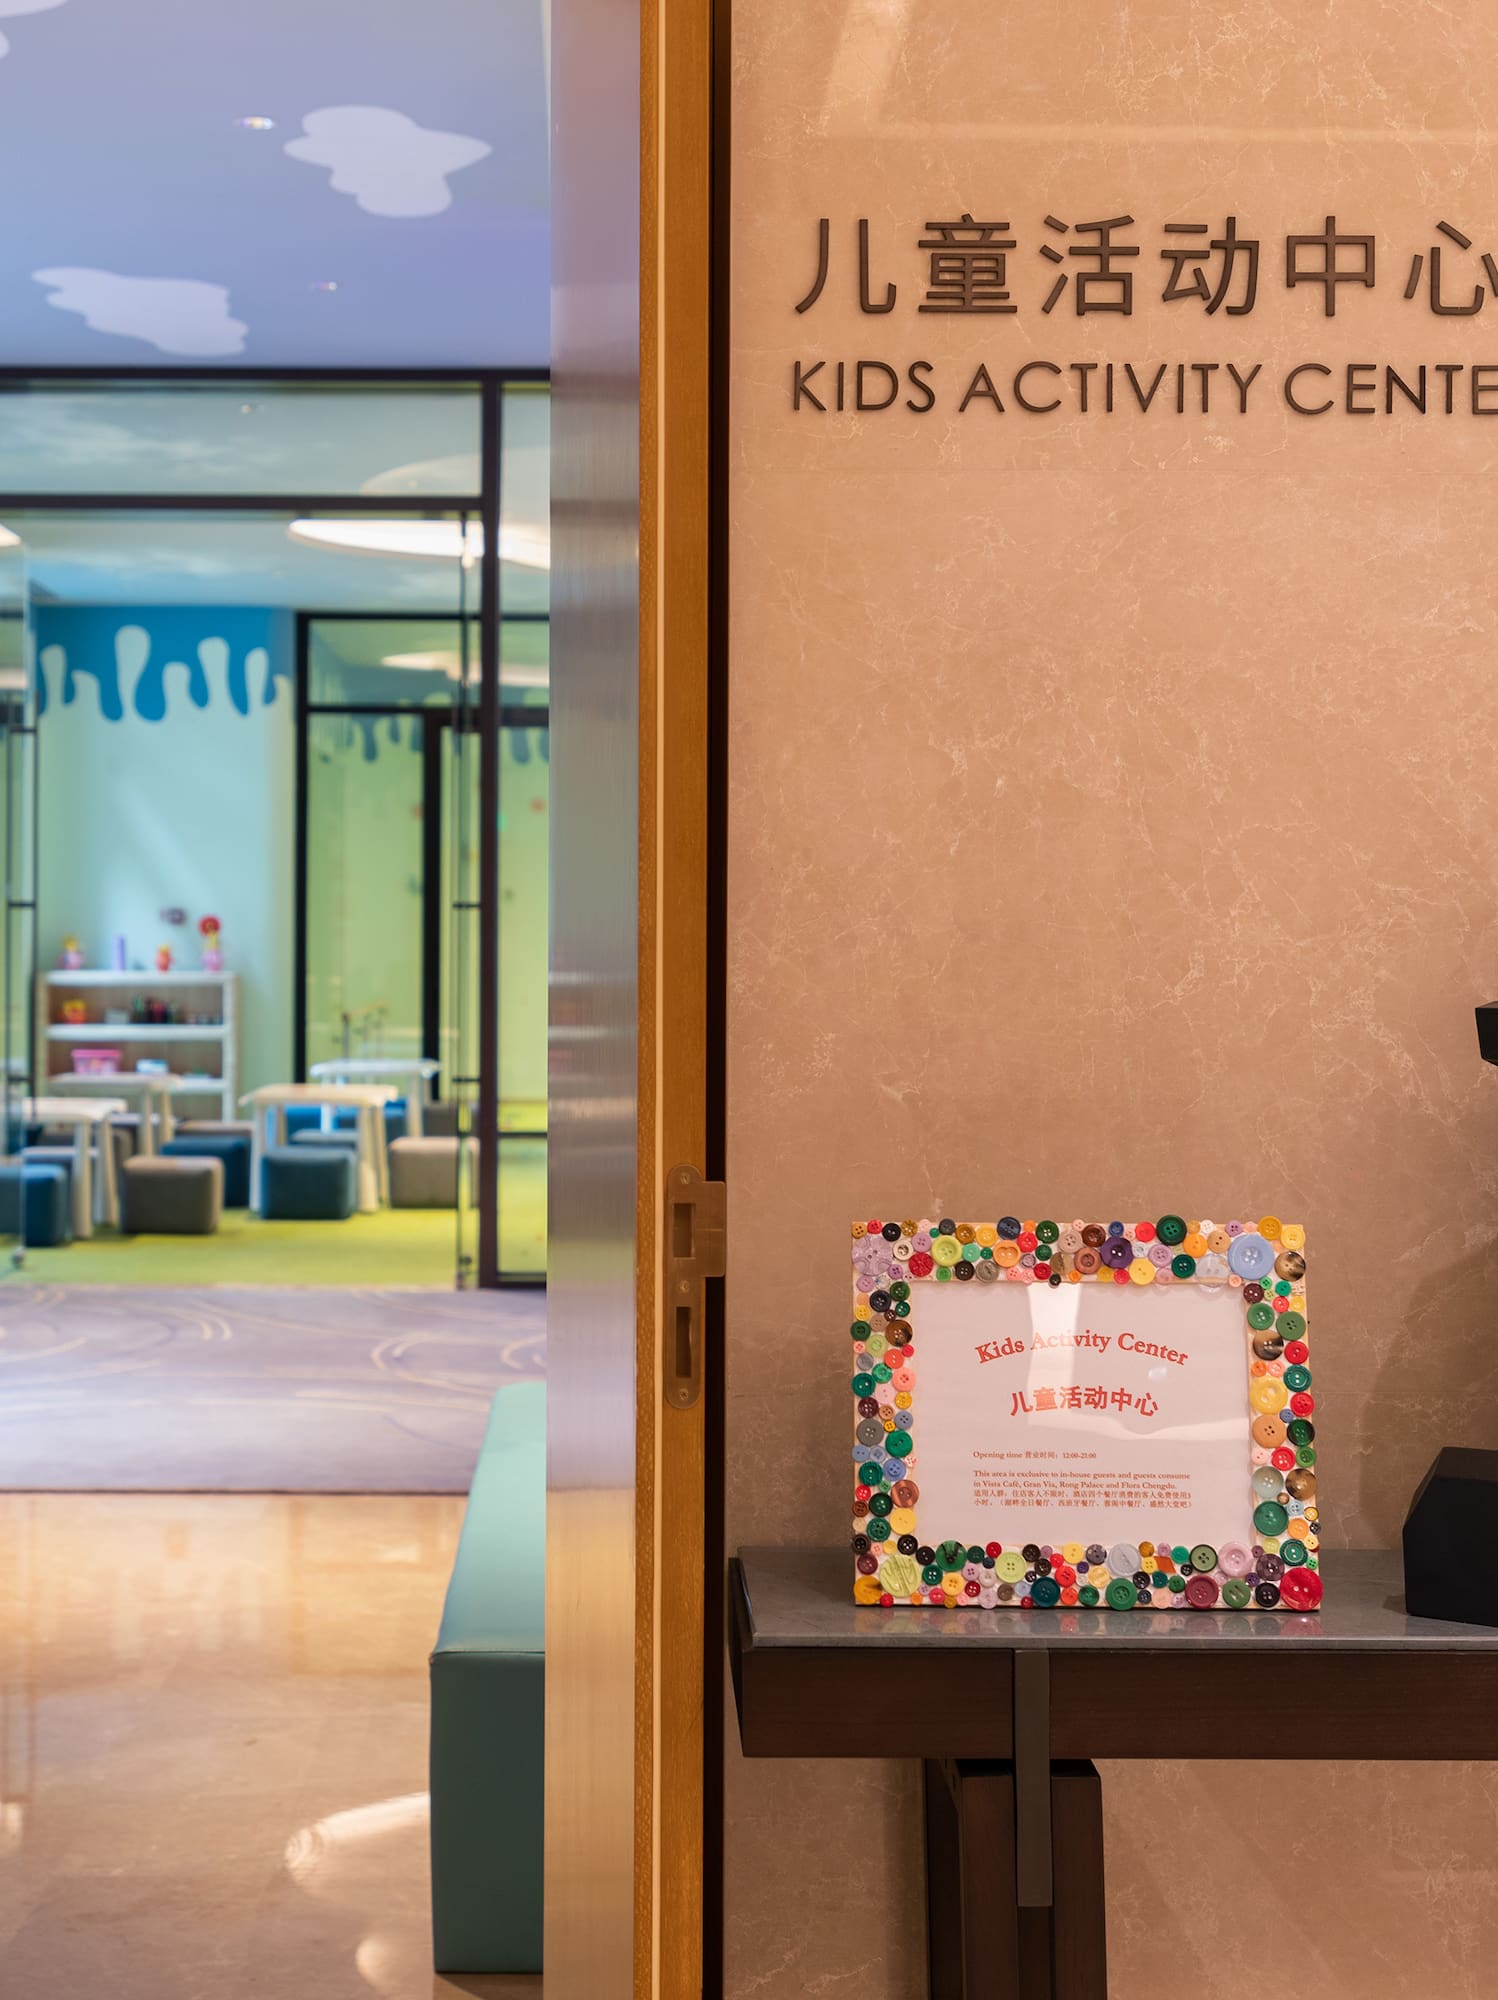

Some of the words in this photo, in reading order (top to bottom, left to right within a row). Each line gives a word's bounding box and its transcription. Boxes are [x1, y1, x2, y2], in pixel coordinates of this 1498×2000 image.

[795, 213, 1498, 317] 儿童活动中心
[793, 361, 935, 413] KIDS
[958, 361, 1263, 414] ACTIVITY
[1284, 363, 1498, 415] CENTE
[975, 1337, 1025, 1364] Kids
[1030, 1329, 1111, 1353] Activity
[1117, 1333, 1188, 1365] Center
[1010, 1385, 1159, 1416] 儿童活动中心
[973, 1451, 1005, 1460] Opening
[1017, 1470, 1049, 1478] exclusive
[1093, 1472, 1116, 1480] guests
[1043, 1481, 1058, 1489] Via,
[1060, 1481, 1079, 1490] Rong
[1106, 1481, 1119, 1489] and
